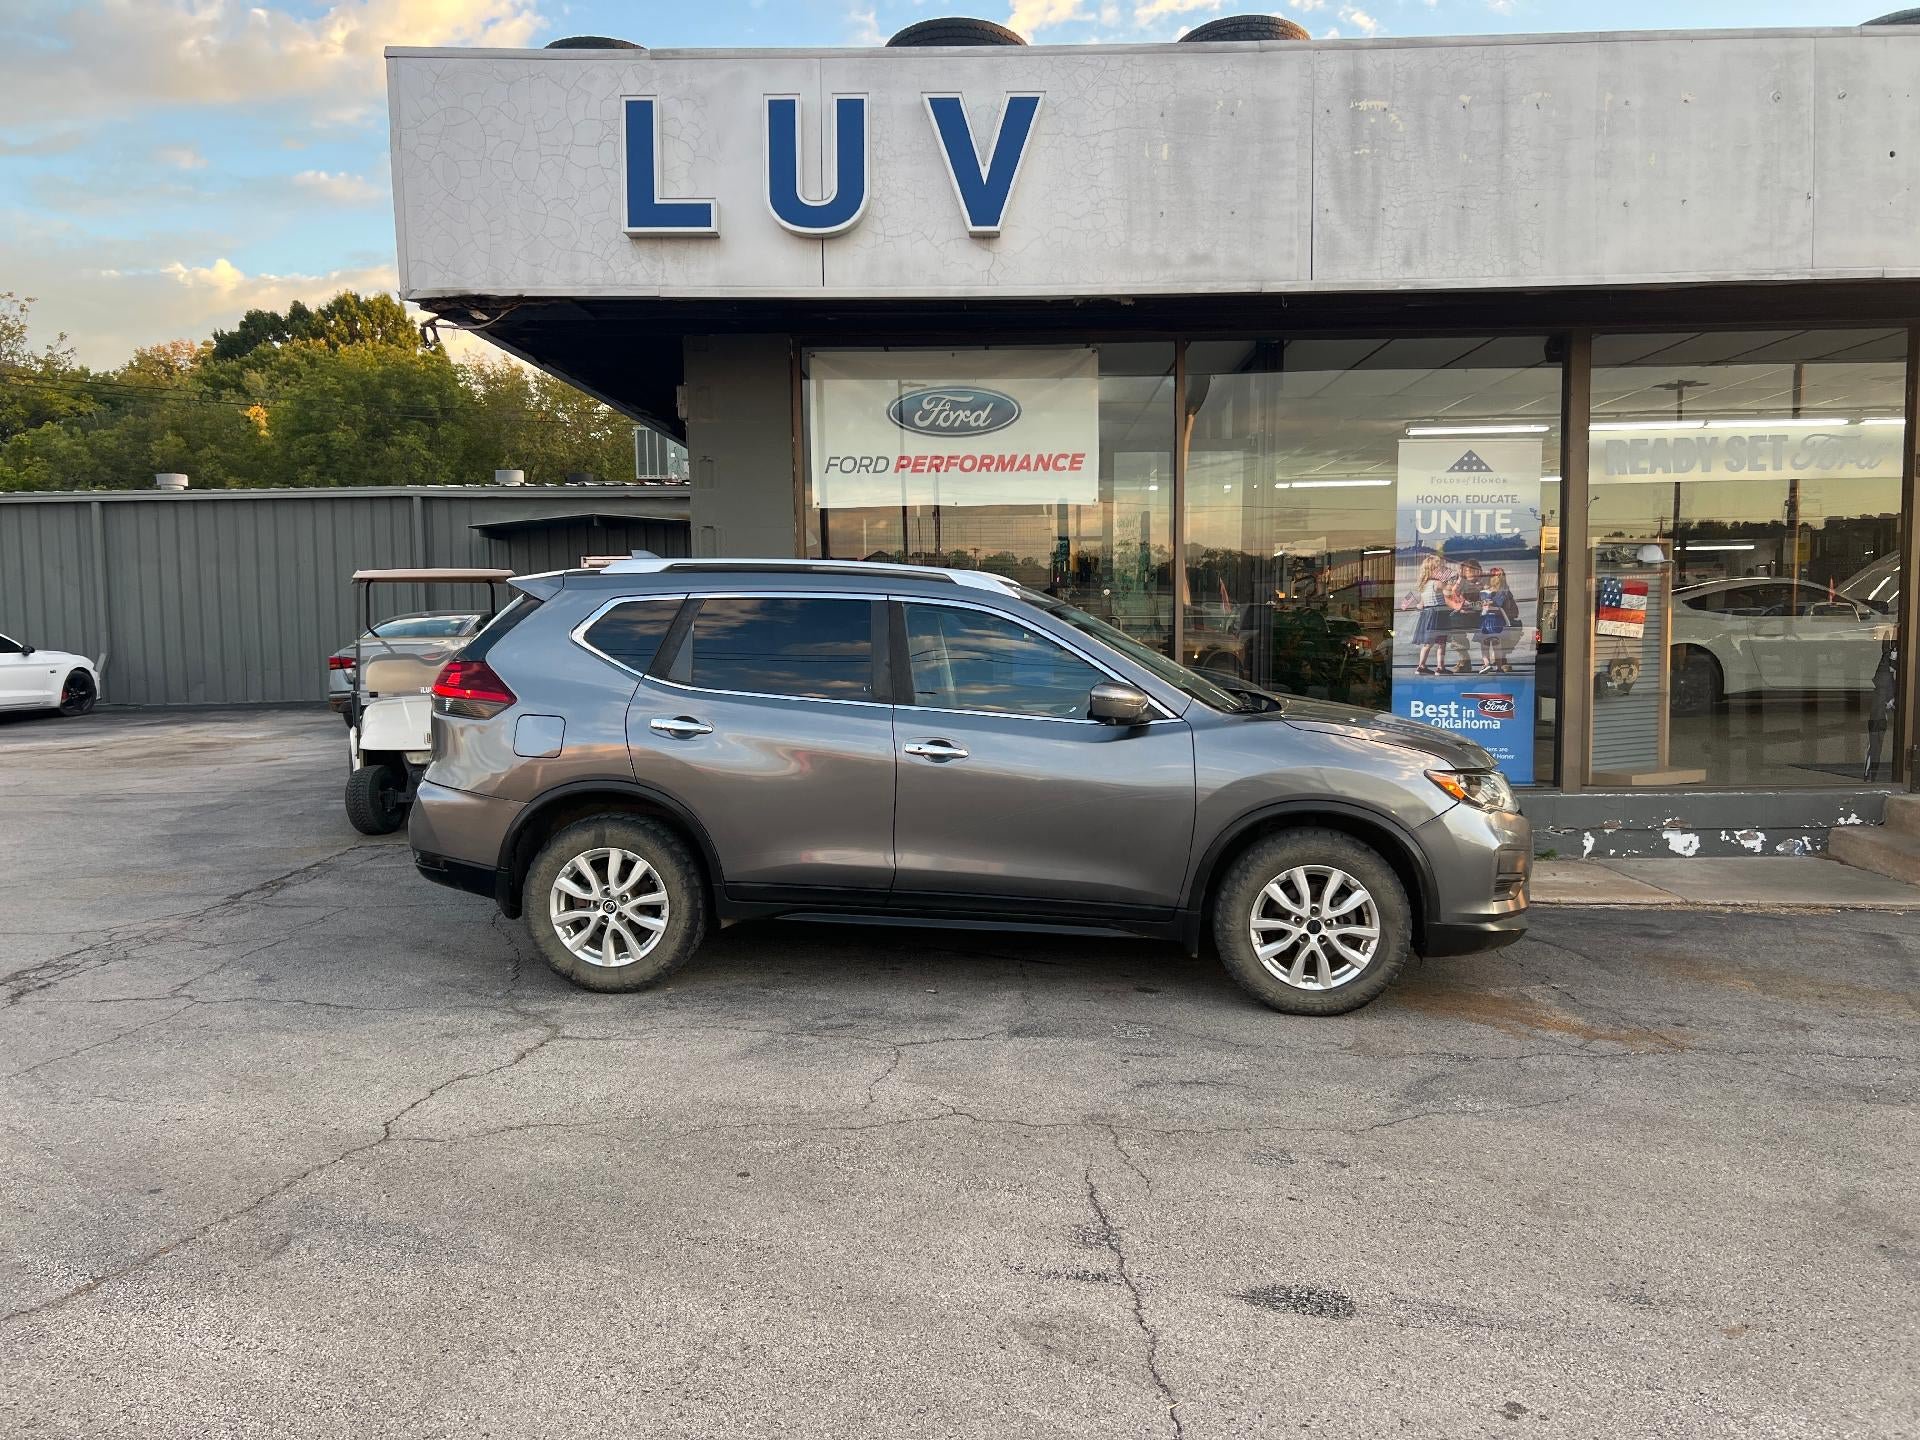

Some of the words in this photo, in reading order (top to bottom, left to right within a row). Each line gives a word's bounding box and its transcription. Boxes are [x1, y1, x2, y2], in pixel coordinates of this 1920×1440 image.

[620, 90, 1046, 238] LUV
[914, 394, 994, 428] Ford
[824, 456, 890, 474] FORD
[893, 453, 1086, 474] PERFORMANCE
[1605, 436, 1719, 476] READY
[1724, 434, 1788, 472] SET
[1415, 508, 1520, 535] UNITE.
[1410, 700, 1459, 718] Best
[1462, 706, 1475, 718] in
[1484, 700, 1509, 712] Ford
[1431, 717, 1501, 730] Oklahoma
